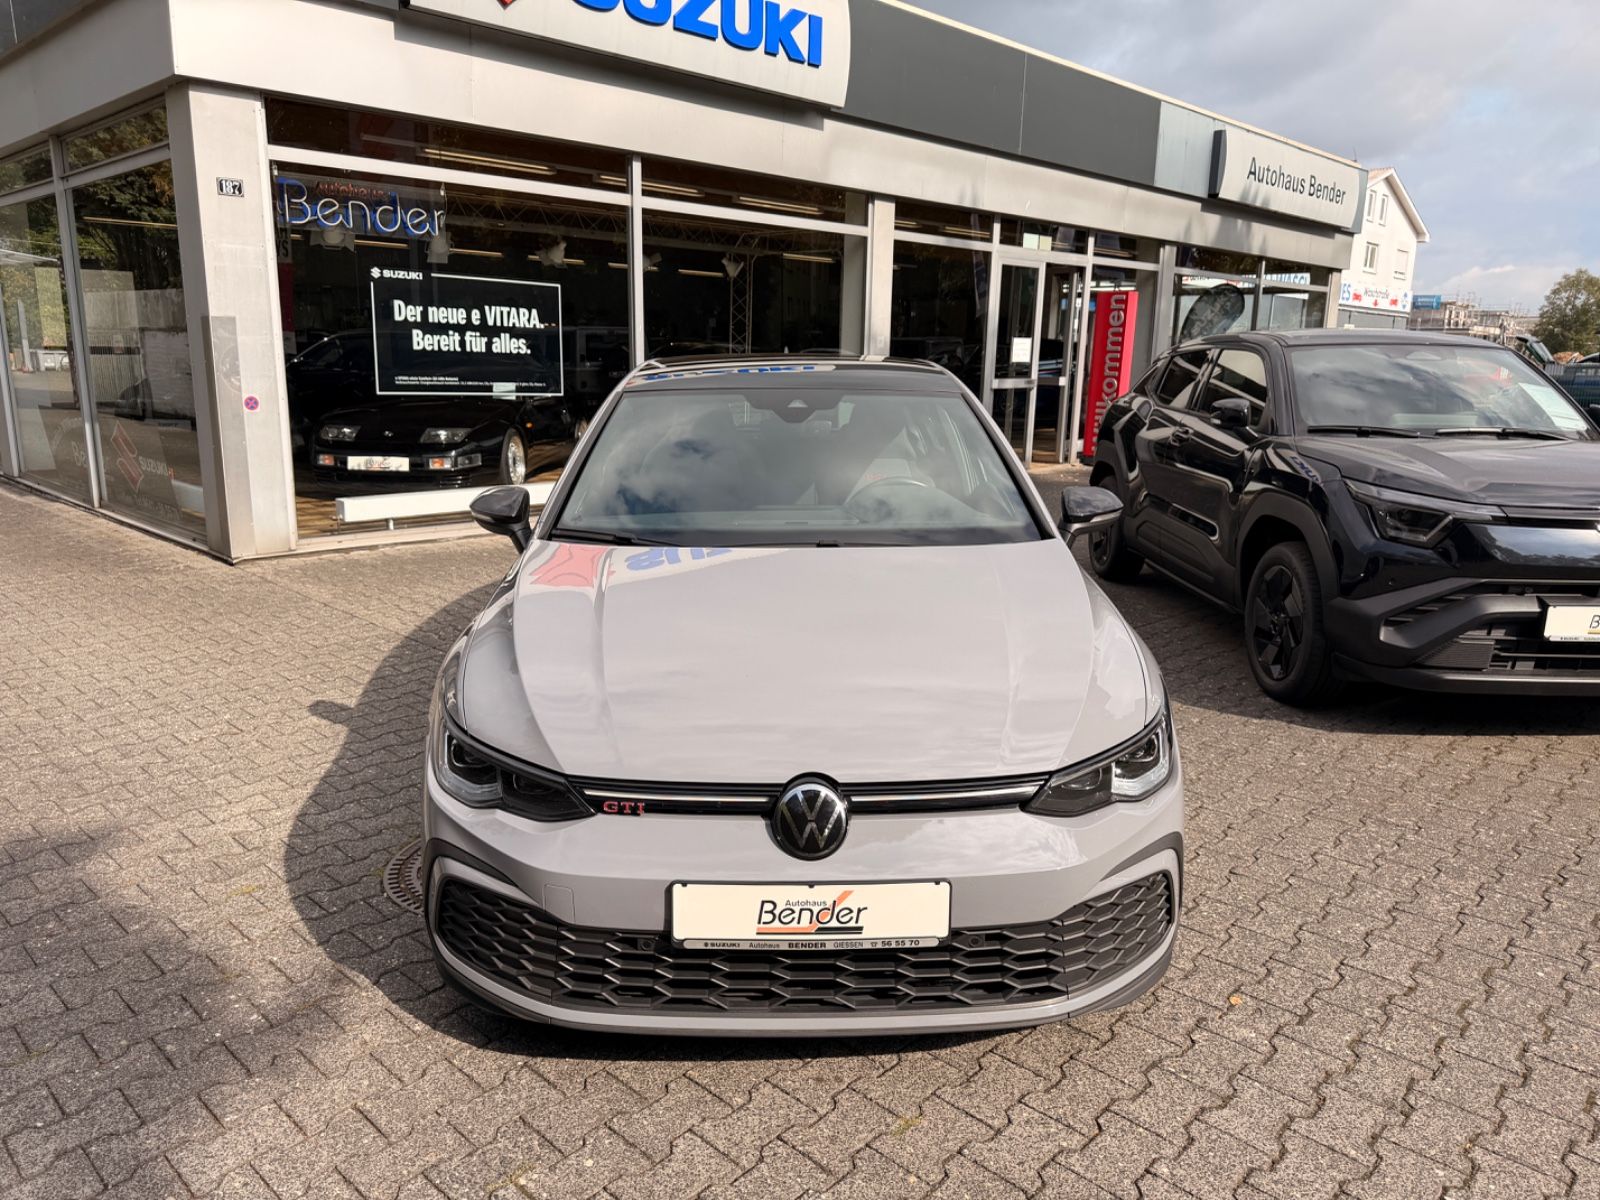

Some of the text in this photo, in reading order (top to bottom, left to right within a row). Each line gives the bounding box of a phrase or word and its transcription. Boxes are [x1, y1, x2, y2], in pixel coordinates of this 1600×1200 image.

[572, 0, 822, 67] ZUKI
[1247, 157, 1347, 205] Autohaus Bender
[279, 179, 446, 236] Bender
[383, 269, 423, 281] SUZUKI
[393, 299, 545, 328] Der neue e VITARA.
[412, 329, 531, 355] Bereit für alles.
[603, 800, 645, 816] GTI
[757, 899, 868, 925] Bender
[784, 899, 827, 907] Autohaus
[749, 941, 780, 949] Autohaus
[788, 941, 827, 949] BENDER
[881, 940, 893, 948] 56
[908, 939, 920, 947] 70
